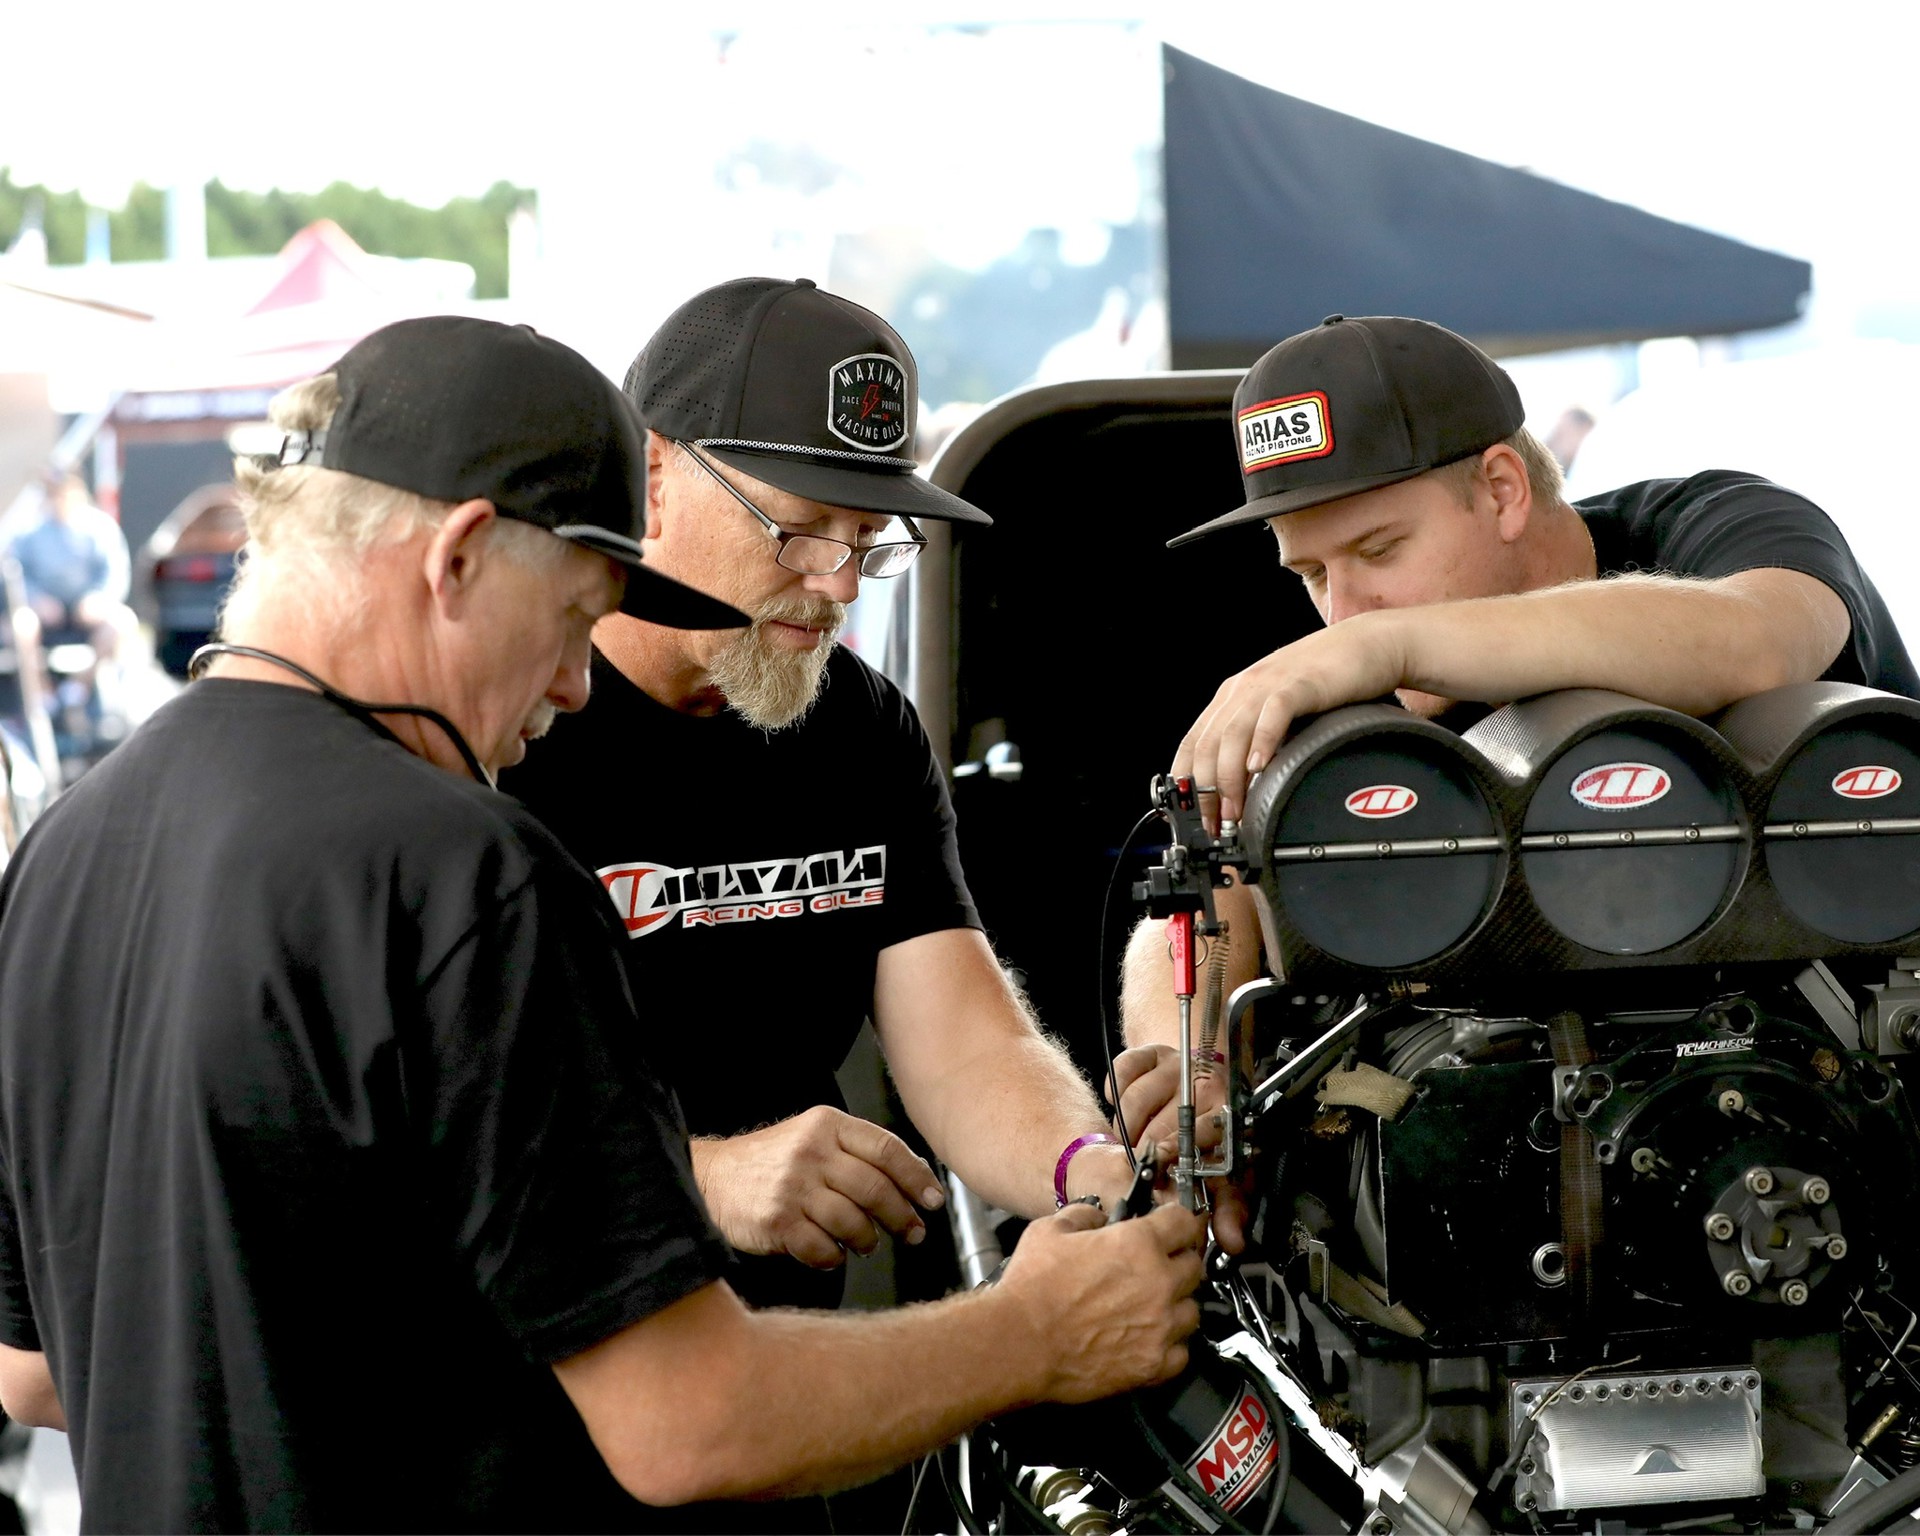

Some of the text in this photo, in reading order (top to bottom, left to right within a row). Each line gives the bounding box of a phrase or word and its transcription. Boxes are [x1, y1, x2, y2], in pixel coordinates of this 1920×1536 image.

[838, 363, 901, 394] MAXIMA
[841, 395, 860, 405] RACE
[836, 413, 902, 440] RACING OILS
[1245, 412, 1310, 449] ARIAS
[1267, 435, 1312, 451] PISTONS
[683, 886, 884, 928] RCING OILS
[1196, 1394, 1267, 1495] MSD
[1212, 1470, 1242, 1505] PRO
[1241, 1431, 1269, 1473] MAG
